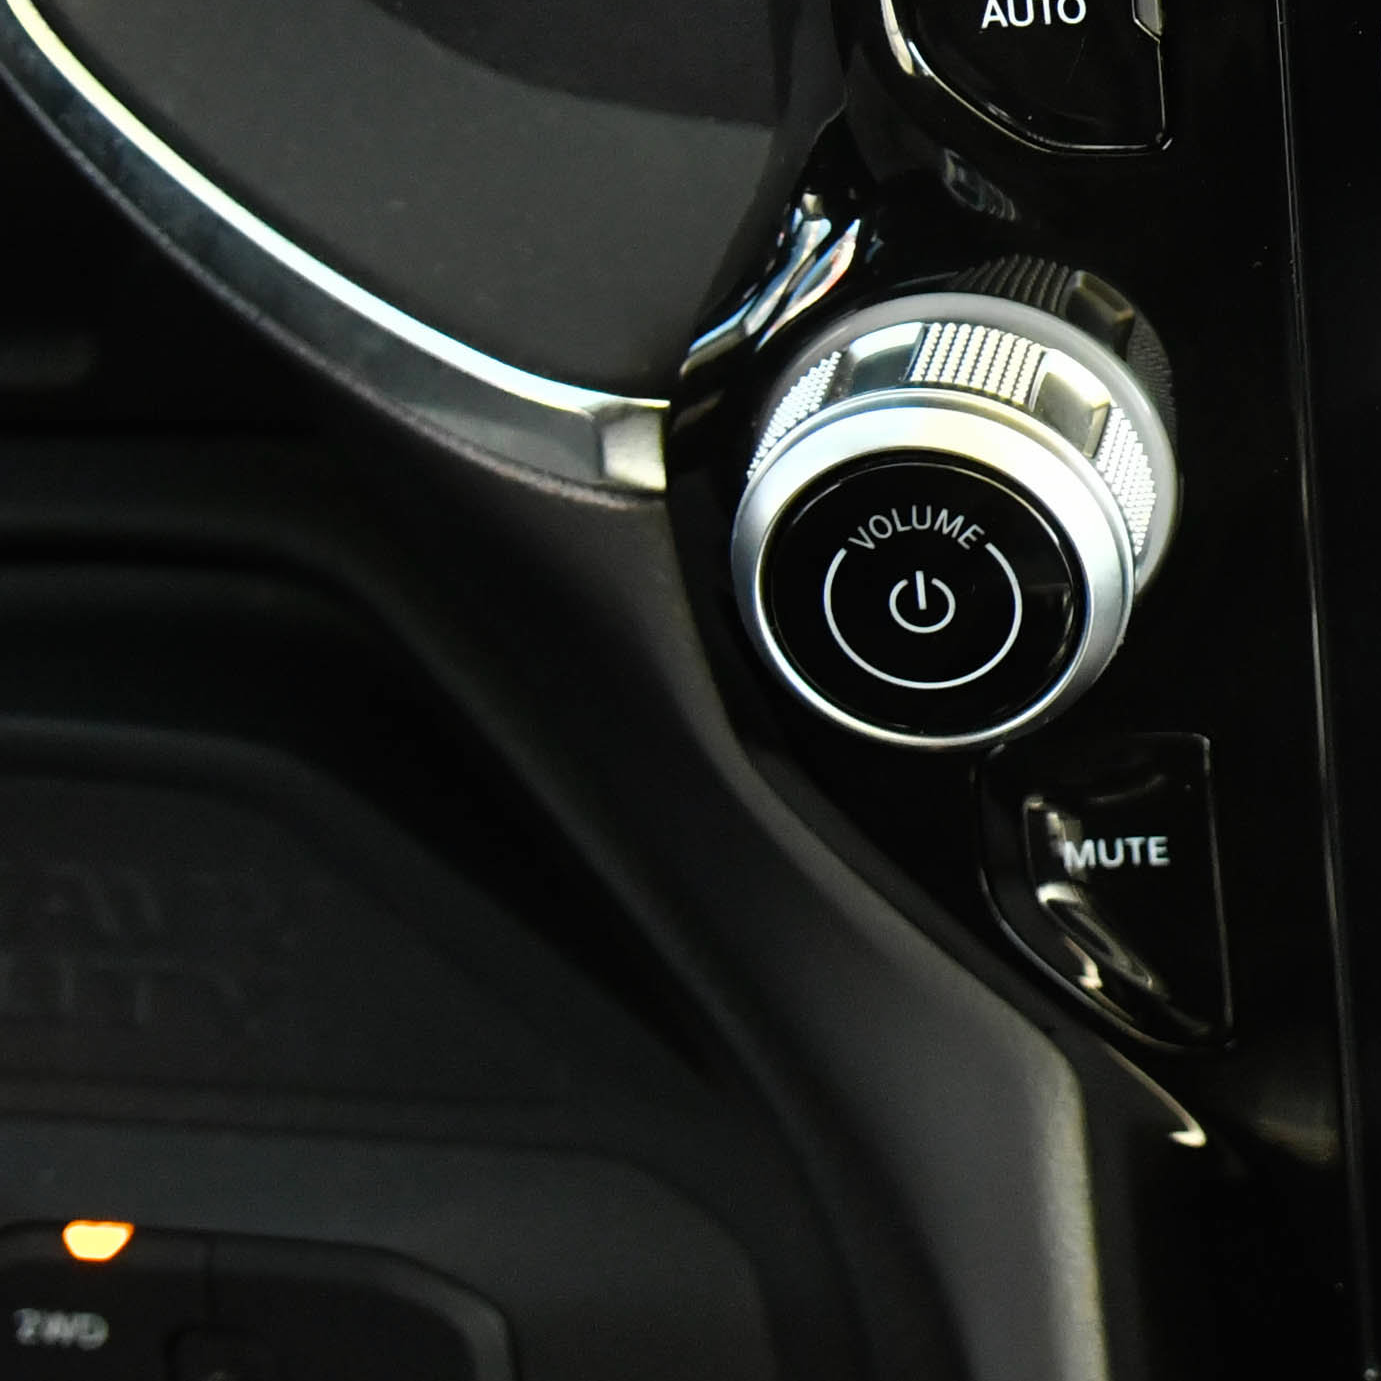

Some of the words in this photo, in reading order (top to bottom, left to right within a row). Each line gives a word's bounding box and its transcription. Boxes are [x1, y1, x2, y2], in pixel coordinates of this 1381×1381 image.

[847, 504, 986, 553] VOLUME
[1062, 835, 1171, 871] MUTE
[14, 1308, 109, 1349] 2WD
